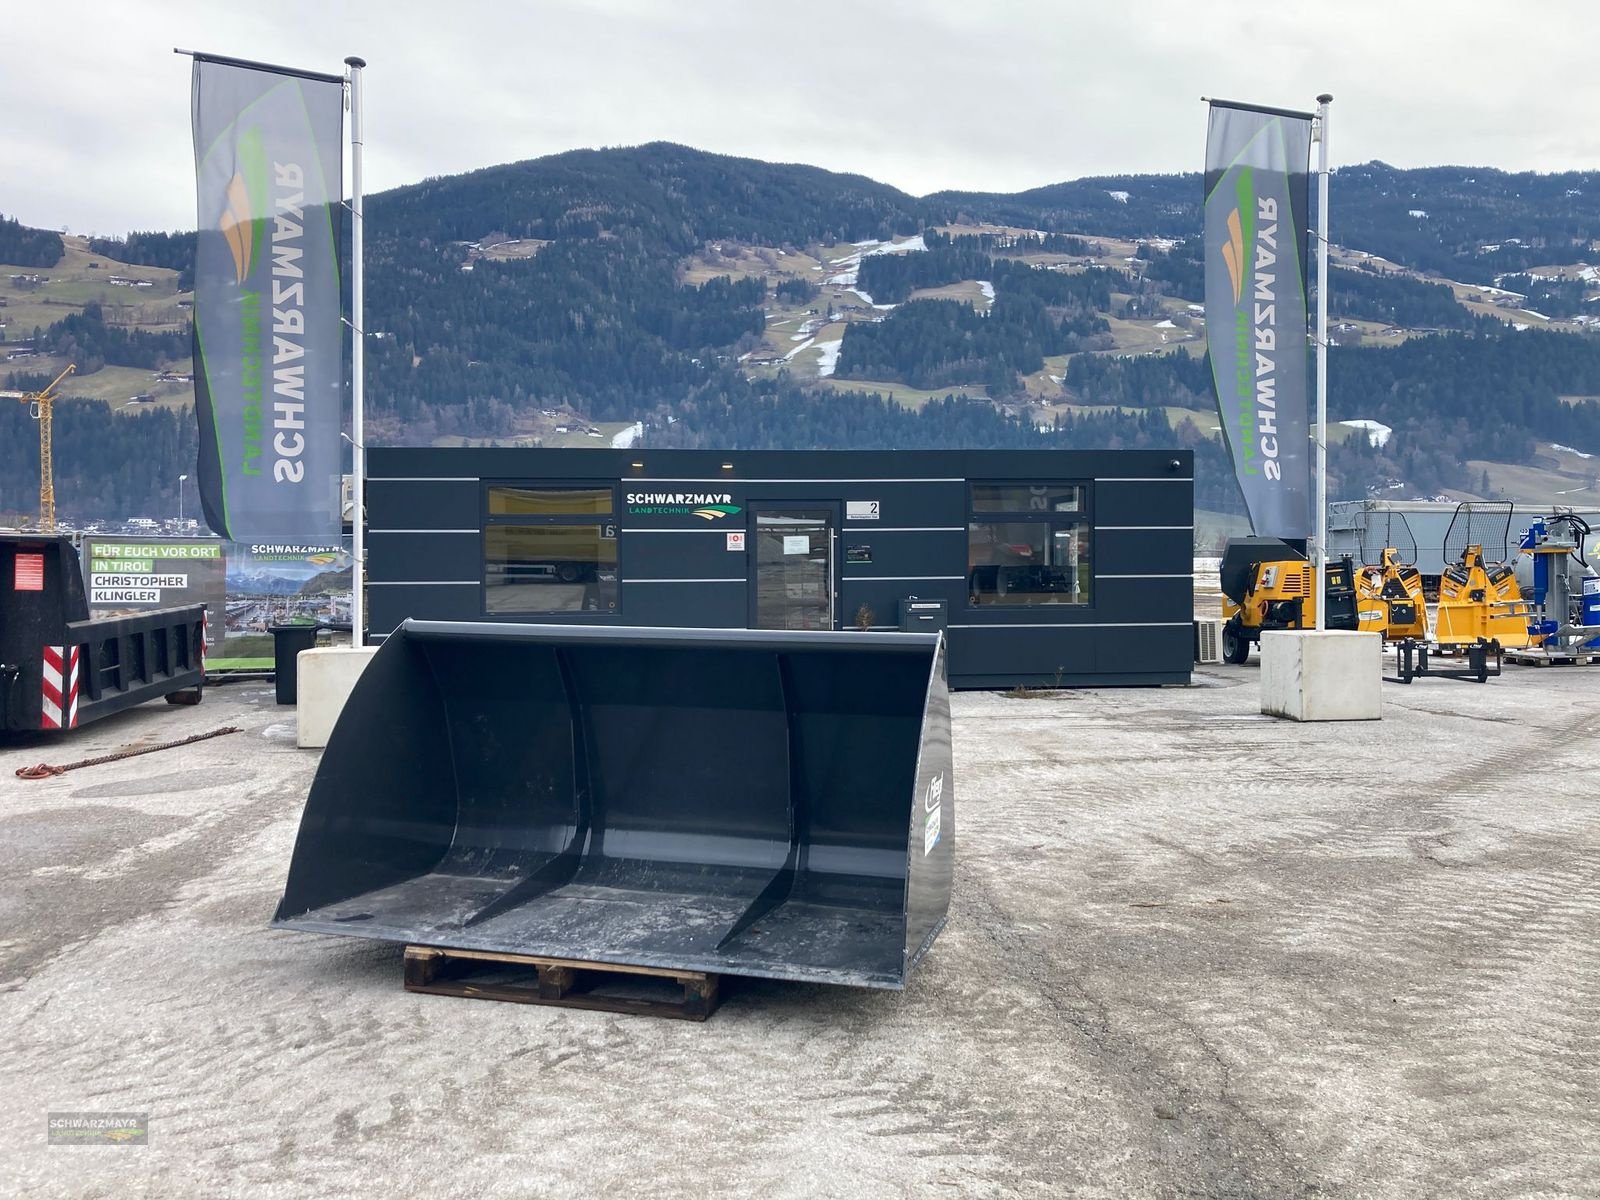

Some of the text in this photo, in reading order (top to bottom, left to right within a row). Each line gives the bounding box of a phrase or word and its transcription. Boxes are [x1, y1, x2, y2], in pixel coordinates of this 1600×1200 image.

[626, 493, 732, 505] SCHWARZMAYR
[628, 506, 690, 514] LANDTECHNIK
[870, 502, 878, 514] 2
[94, 544, 217, 558] FÜR EUCH VOR ORT
[95, 561, 150, 572] IN TIROL
[94, 576, 184, 586] CHRISTOPHER
[94, 591, 157, 601] KLINGLER
